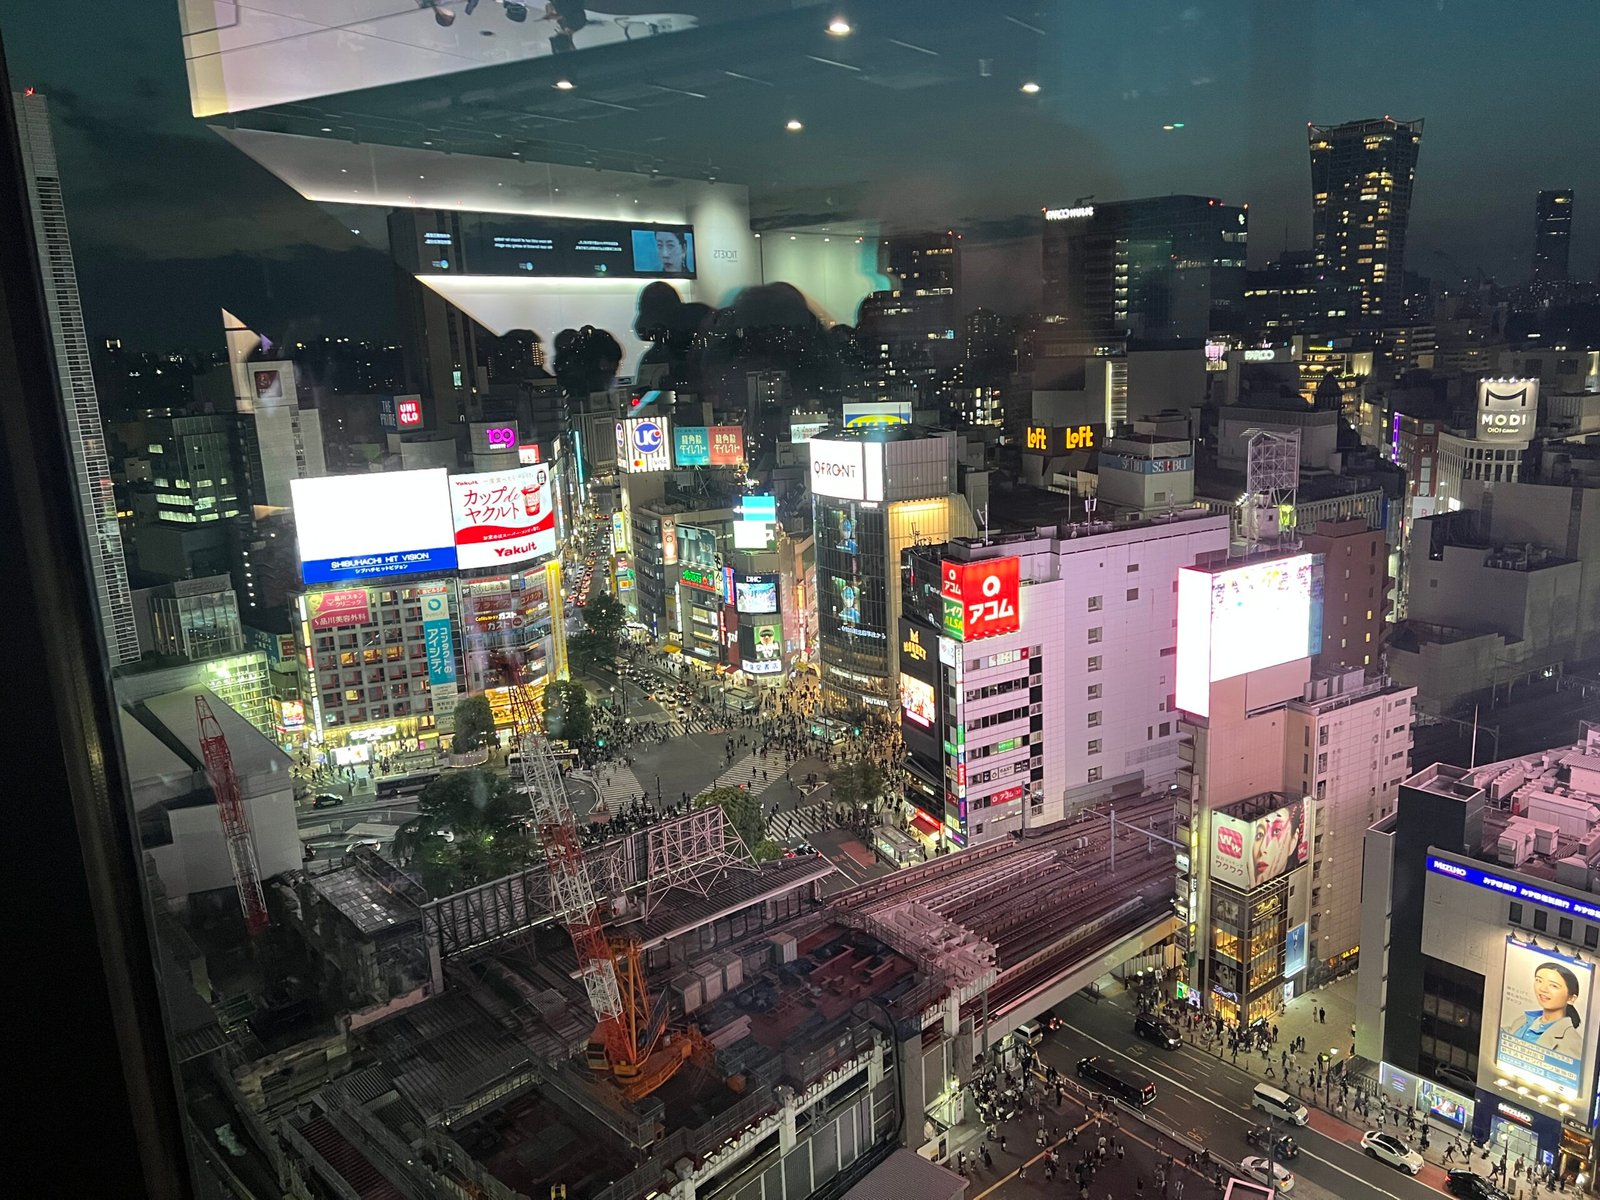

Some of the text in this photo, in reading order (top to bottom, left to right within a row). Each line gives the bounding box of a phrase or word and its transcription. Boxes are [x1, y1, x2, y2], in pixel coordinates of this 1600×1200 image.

[400, 403, 416, 412] UNI
[401, 412, 418, 423] QLO
[1481, 414, 1526, 426] MODI
[486, 428, 516, 449] 109
[1152, 459, 1187, 473] SEIBU
[464, 486, 507, 507] カップ
[465, 502, 519, 524] ヤクルト
[494, 542, 537, 557] Yakult
[331, 552, 429, 569] SHIBUHACHI HIT VISION
[944, 580, 962, 595] アコム
[498, 611, 517, 621] ガスト
[969, 598, 1014, 624] アコム
[320, 614, 366, 625] 品川美容外科
[487, 620, 510, 631] ガスト
[427, 628, 441, 674] アイシティ
[440, 627, 452, 674] コンタクトの
[862, 695, 888, 707] TSUTAYA
[1216, 860, 1243, 876] ワクワク
[1433, 861, 1467, 876] MIZUHO
